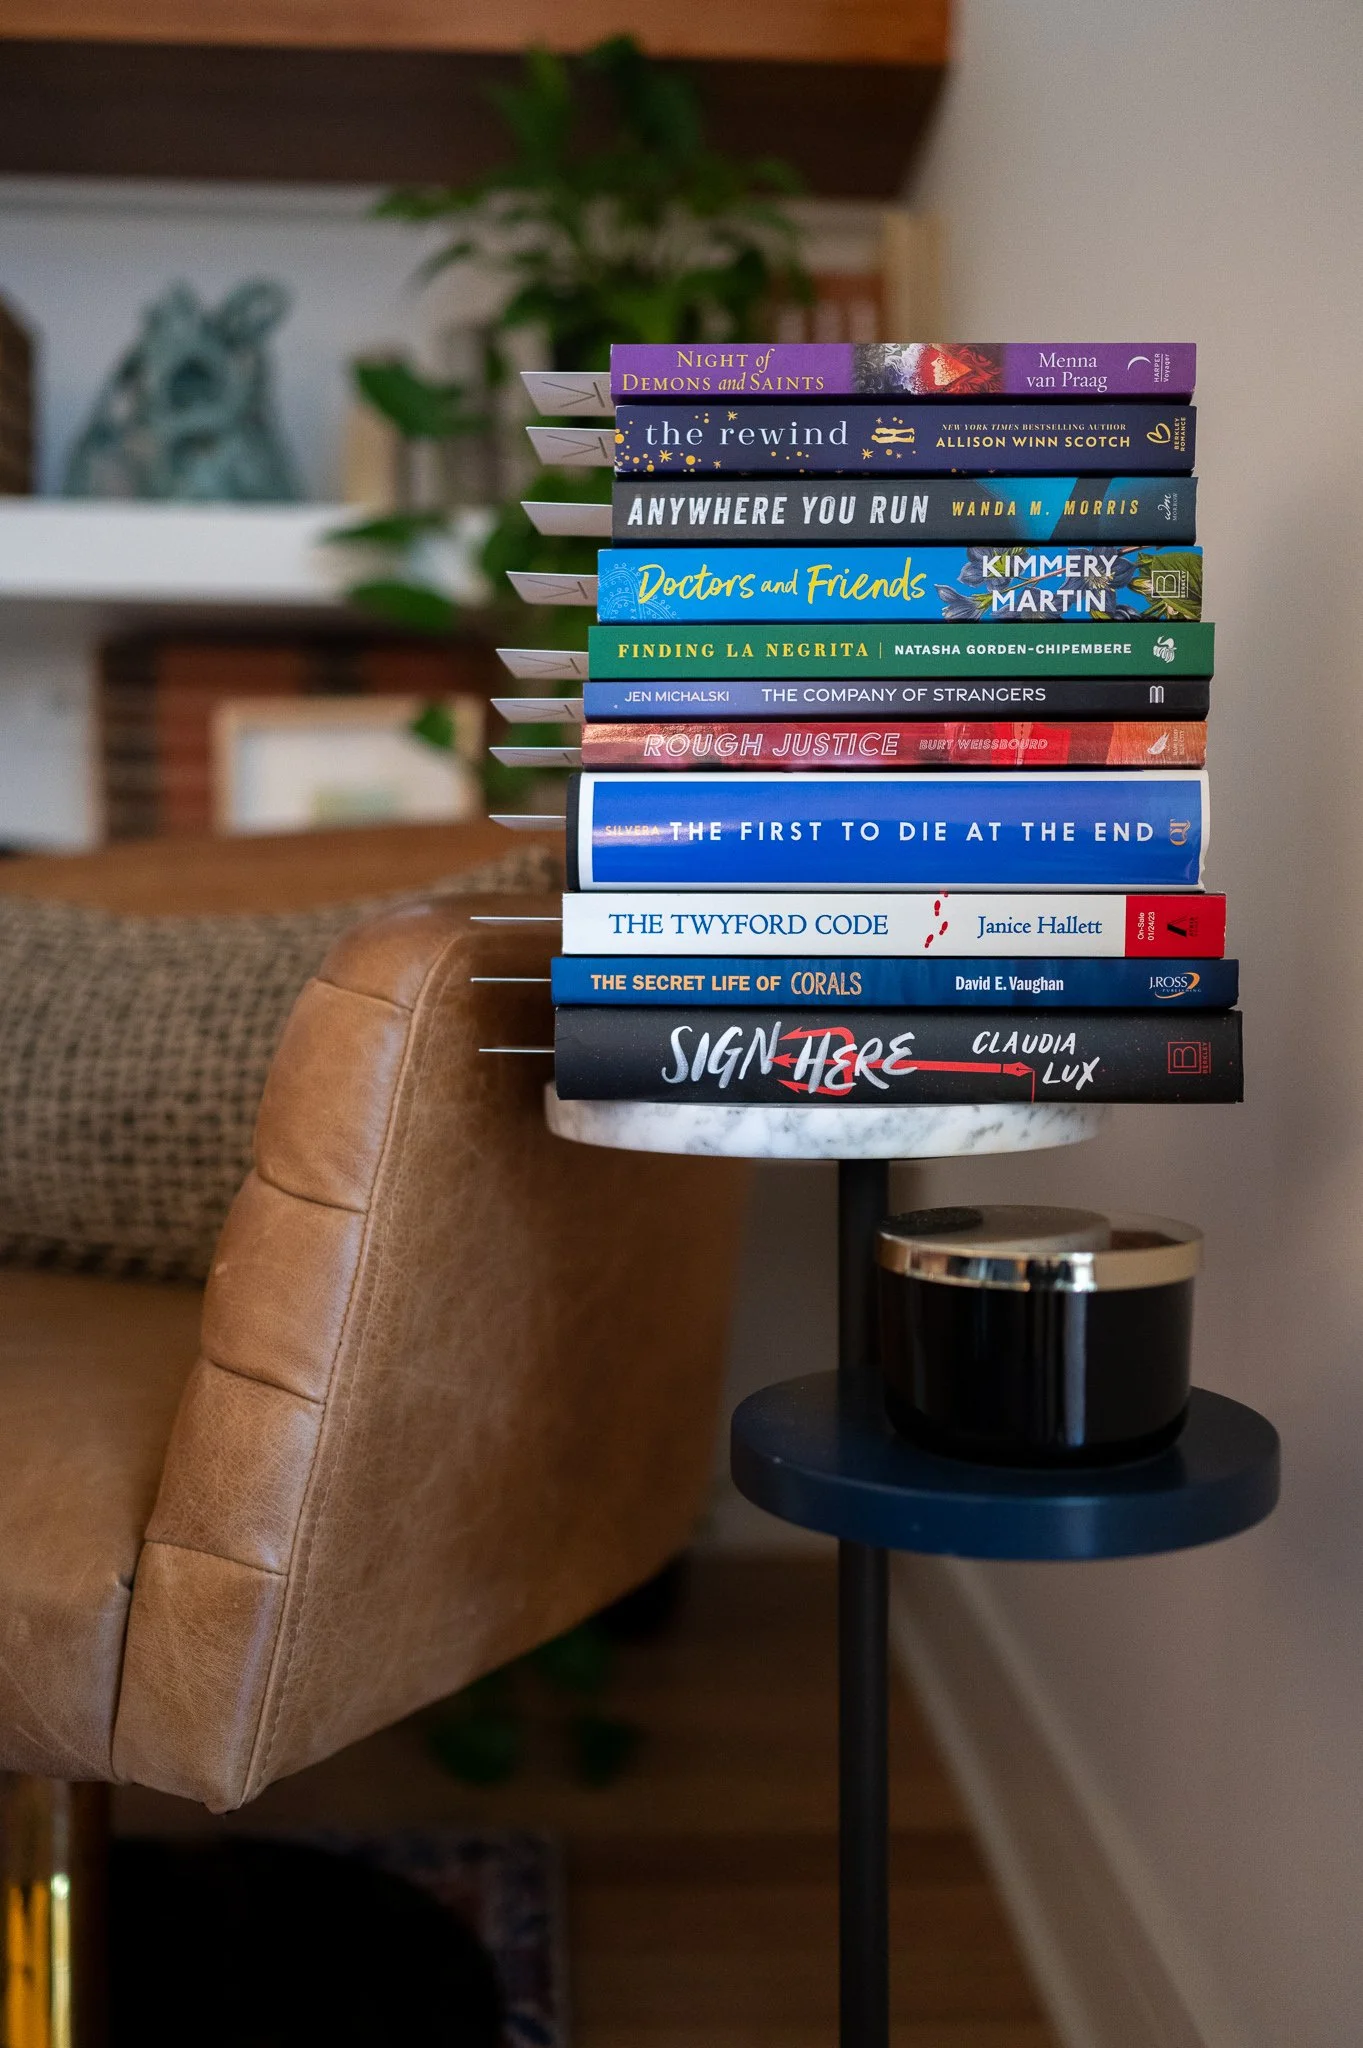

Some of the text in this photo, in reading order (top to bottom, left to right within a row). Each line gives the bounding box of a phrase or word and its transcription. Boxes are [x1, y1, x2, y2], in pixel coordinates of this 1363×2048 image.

[755, 348, 775, 374] of
[1039, 352, 1098, 368] Menna
[1153, 353, 1161, 383] HARPER
[1163, 354, 1171, 383] Voyager
[718, 371, 746, 391] and
[1026, 371, 1108, 393] van Praag
[645, 420, 849, 446] the rewind
[941, 423, 1127, 431] NEW YORK TIMES BESTSELLING AUTHOR
[1173, 417, 1181, 450] BERKLEY
[935, 436, 1131, 448] ALLISON WINN SCOTCH
[627, 495, 929, 526] ANYWHERE YOU RUN
[951, 499, 1139, 517] WANDA M. MORRIS
[982, 555, 1119, 578] KIMMERY
[637, 556, 926, 605] Doctors and Friends
[991, 589, 1106, 613] MARTIN
[617, 642, 869, 658] FINDING LA NEGRITA
[894, 643, 1132, 655] NATASHA GORDEN-CHIPEMBERE
[624, 690, 730, 702] JEN MICHALSKI
[761, 688, 1047, 702] THE COMPANY OF STRANGERS
[644, 732, 900, 757] ROUGH JUSTICE
[919, 738, 1048, 750] BURT WEISSBOURD
[605, 825, 660, 837] SILVERA
[669, 821, 1154, 842] THE FIRST TO DIE AT THE END
[608, 913, 889, 935] THE TWYFORD CODE
[977, 916, 1103, 939] Janice Hallett
[1137, 912, 1145, 940] On-Sale
[1147, 911, 1155, 941] 01/24/23
[590, 974, 782, 991] THE SECRET LIFE OF
[790, 971, 863, 996] CORALS
[955, 976, 1064, 993] David E. Vaughan
[1148, 976, 1189, 989] J.ROSS
[972, 1031, 1077, 1055] CLAUDIA
[661, 1021, 918, 1094] SIGN HERE
[1042, 1056, 1100, 1090] LUX
